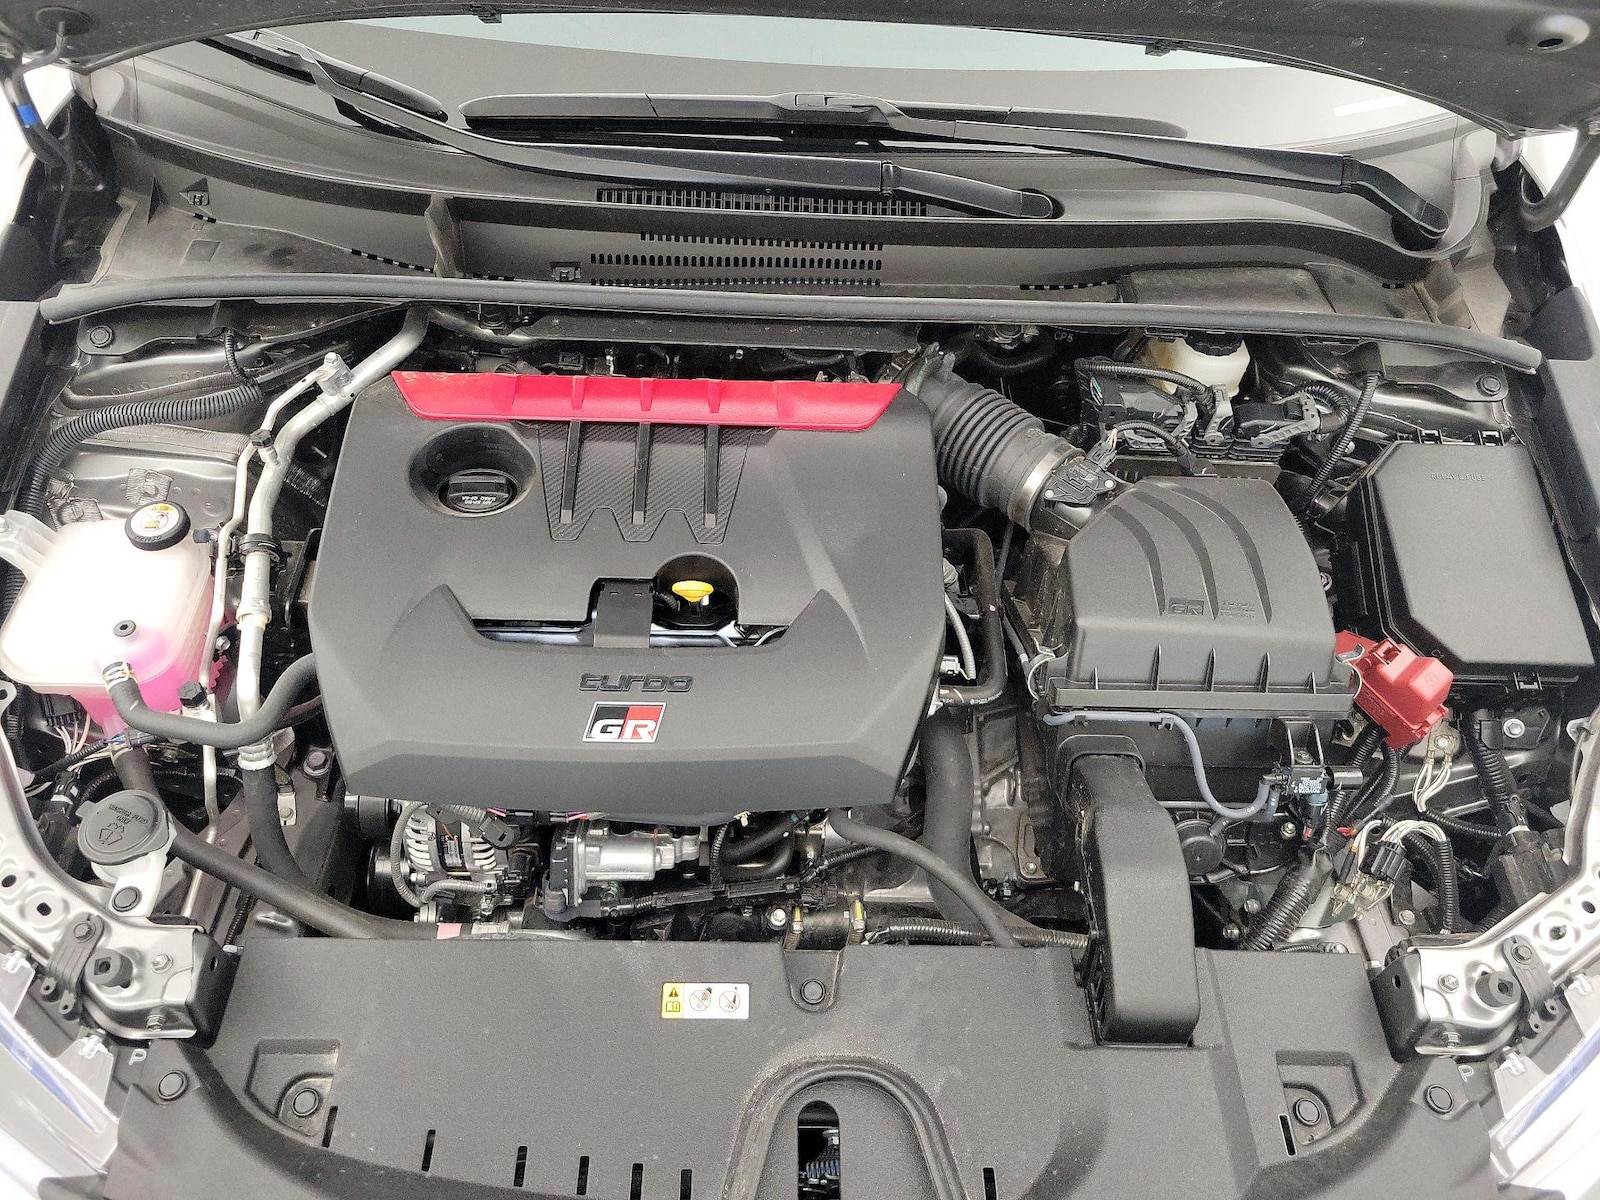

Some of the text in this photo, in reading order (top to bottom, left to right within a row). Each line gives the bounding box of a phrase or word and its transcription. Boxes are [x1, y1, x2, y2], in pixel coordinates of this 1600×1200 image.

[1430, 472, 1455, 481] RELAY
[1465, 473, 1486, 482] FUSE
[579, 673, 694, 692] turbo
[590, 718, 659, 741] GR
